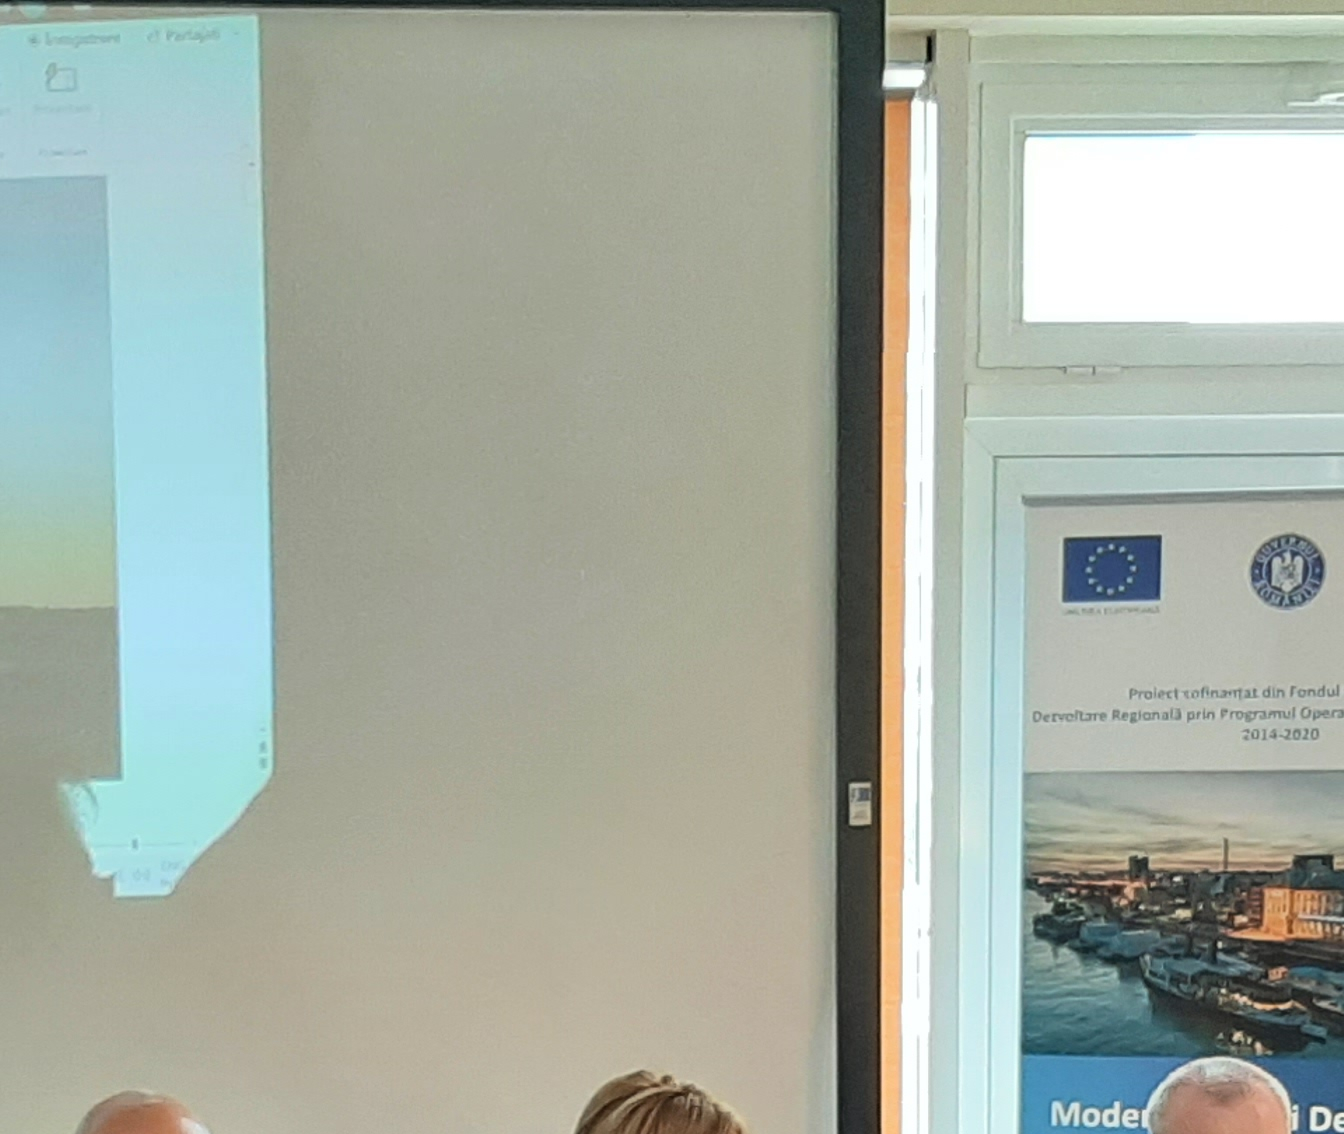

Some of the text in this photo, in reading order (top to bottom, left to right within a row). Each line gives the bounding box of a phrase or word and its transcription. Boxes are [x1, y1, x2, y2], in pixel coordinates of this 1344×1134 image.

[1129, 687, 1179, 701] Proiect
[1262, 686, 1285, 699] din
[1289, 685, 1340, 698] Fondul
[1032, 709, 1107, 723] Dezvoltare
[1112, 708, 1182, 723] Regională
[1187, 708, 1215, 723] prin
[1221, 708, 1296, 722] Programul
[1242, 728, 1320, 741] 2014-2020
